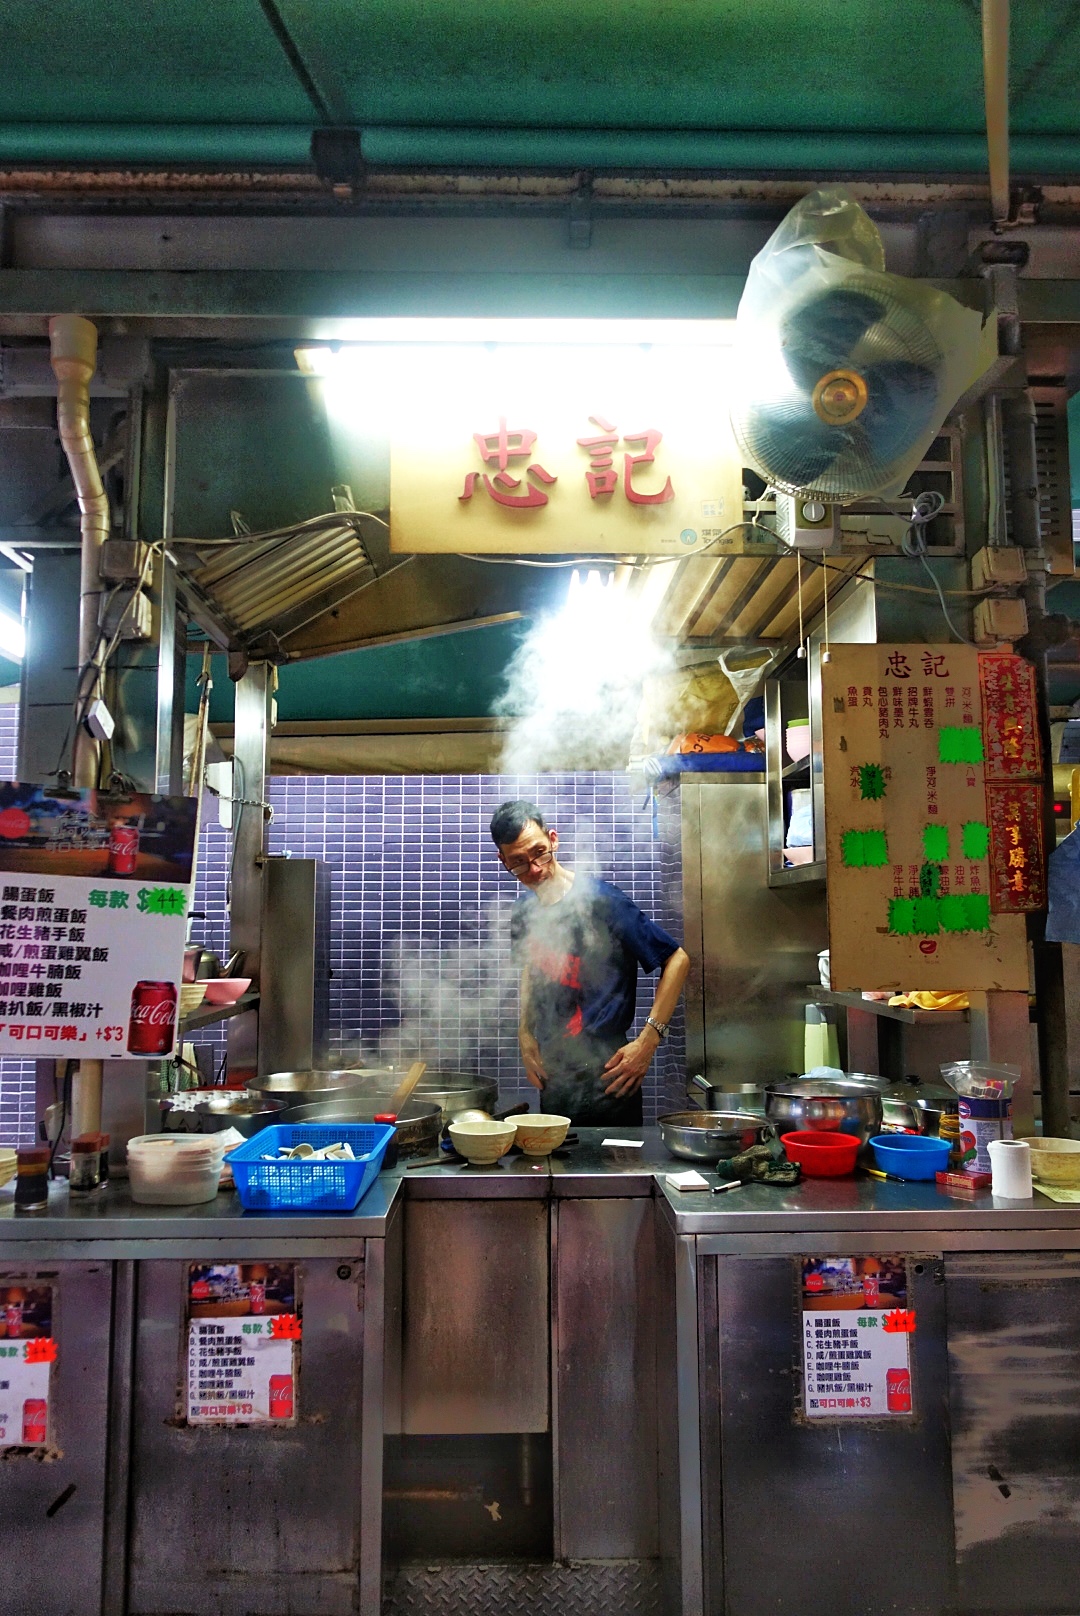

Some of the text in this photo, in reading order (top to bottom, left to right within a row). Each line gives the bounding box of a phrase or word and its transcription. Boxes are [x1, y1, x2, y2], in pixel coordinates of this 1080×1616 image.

[458, 415, 675, 508] 忠記
[885, 651, 949, 678] 忠記
[848, 687, 858, 707] 魚蛋
[863, 687, 873, 706] 貢丸
[878, 687, 889, 739] 包心豬肉丸
[893, 687, 904, 728] 鮮味墨丸
[908, 687, 919, 728] 招牌牛丸
[923, 687, 934, 728] 鮮蝦雲吞
[850, 767, 860, 787] 汽水
[893, 865, 904, 897] 淨牛肚
[955, 865, 965, 886] 油菜
[2, 886, 55, 903] 腸蛋飯
[88, 889, 129, 909] 每款
[158, 893, 178, 909] 44
[0, 905, 87, 924] 餐肉煎蛋飯
[0, 924, 85, 942] 花生豬手飯
